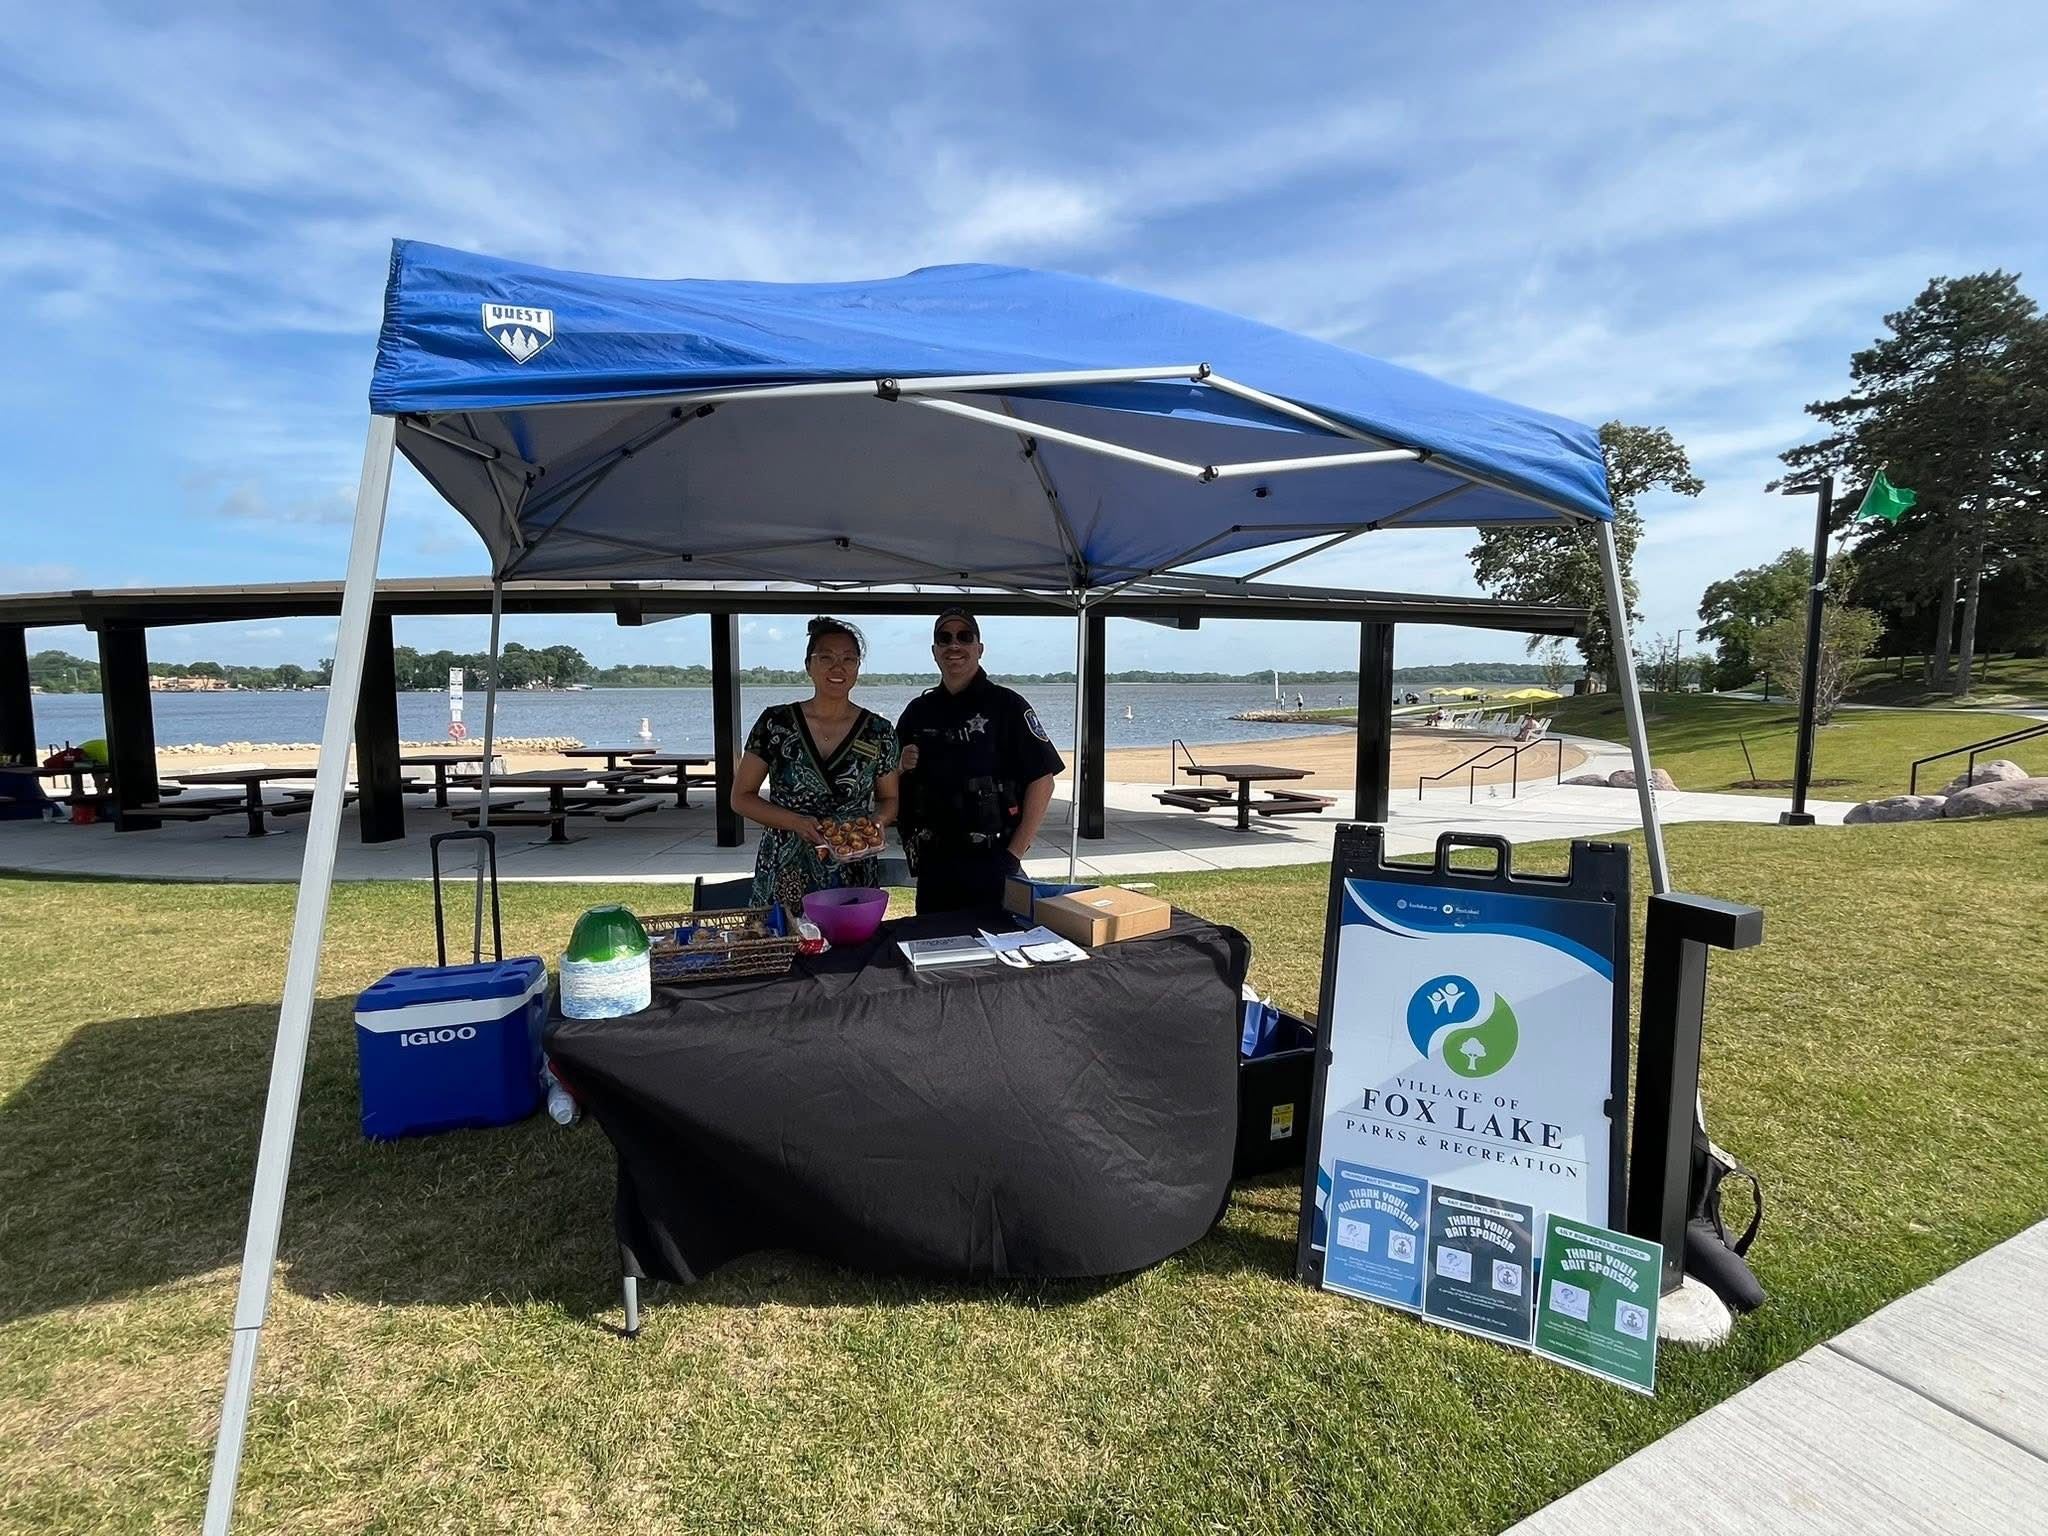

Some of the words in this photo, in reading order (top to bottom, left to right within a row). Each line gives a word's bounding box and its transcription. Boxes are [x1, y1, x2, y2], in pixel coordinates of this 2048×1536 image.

[492, 306, 543, 323] QUEST
[400, 1026, 477, 1047] IGLOO
[1396, 1077, 1482, 1103] VILLAGE
[1494, 1096, 1519, 1110] OF
[1362, 1087, 1437, 1124] FOX
[1454, 1106, 1564, 1150] LAKE
[1346, 1119, 1407, 1142] PARKS
[1417, 1135, 1427, 1146] &
[1439, 1139, 1578, 1178] RECREATION
[1349, 1188, 1379, 1199] THANK
[1338, 1198, 1372, 1213] ANGLER
[1375, 1200, 1420, 1231] DONATION
[1447, 1215, 1481, 1226] THANK
[1483, 1219, 1513, 1240] YOU!!
[1444, 1226, 1467, 1239] BAIT
[1470, 1227, 1516, 1254] SPONSOR
[1560, 1259, 1585, 1271] BAIT
[1588, 1261, 1640, 1293] SPONSOR
[1565, 1248, 1602, 1262] THANK
[1606, 1254, 1638, 1280] YOU!!
